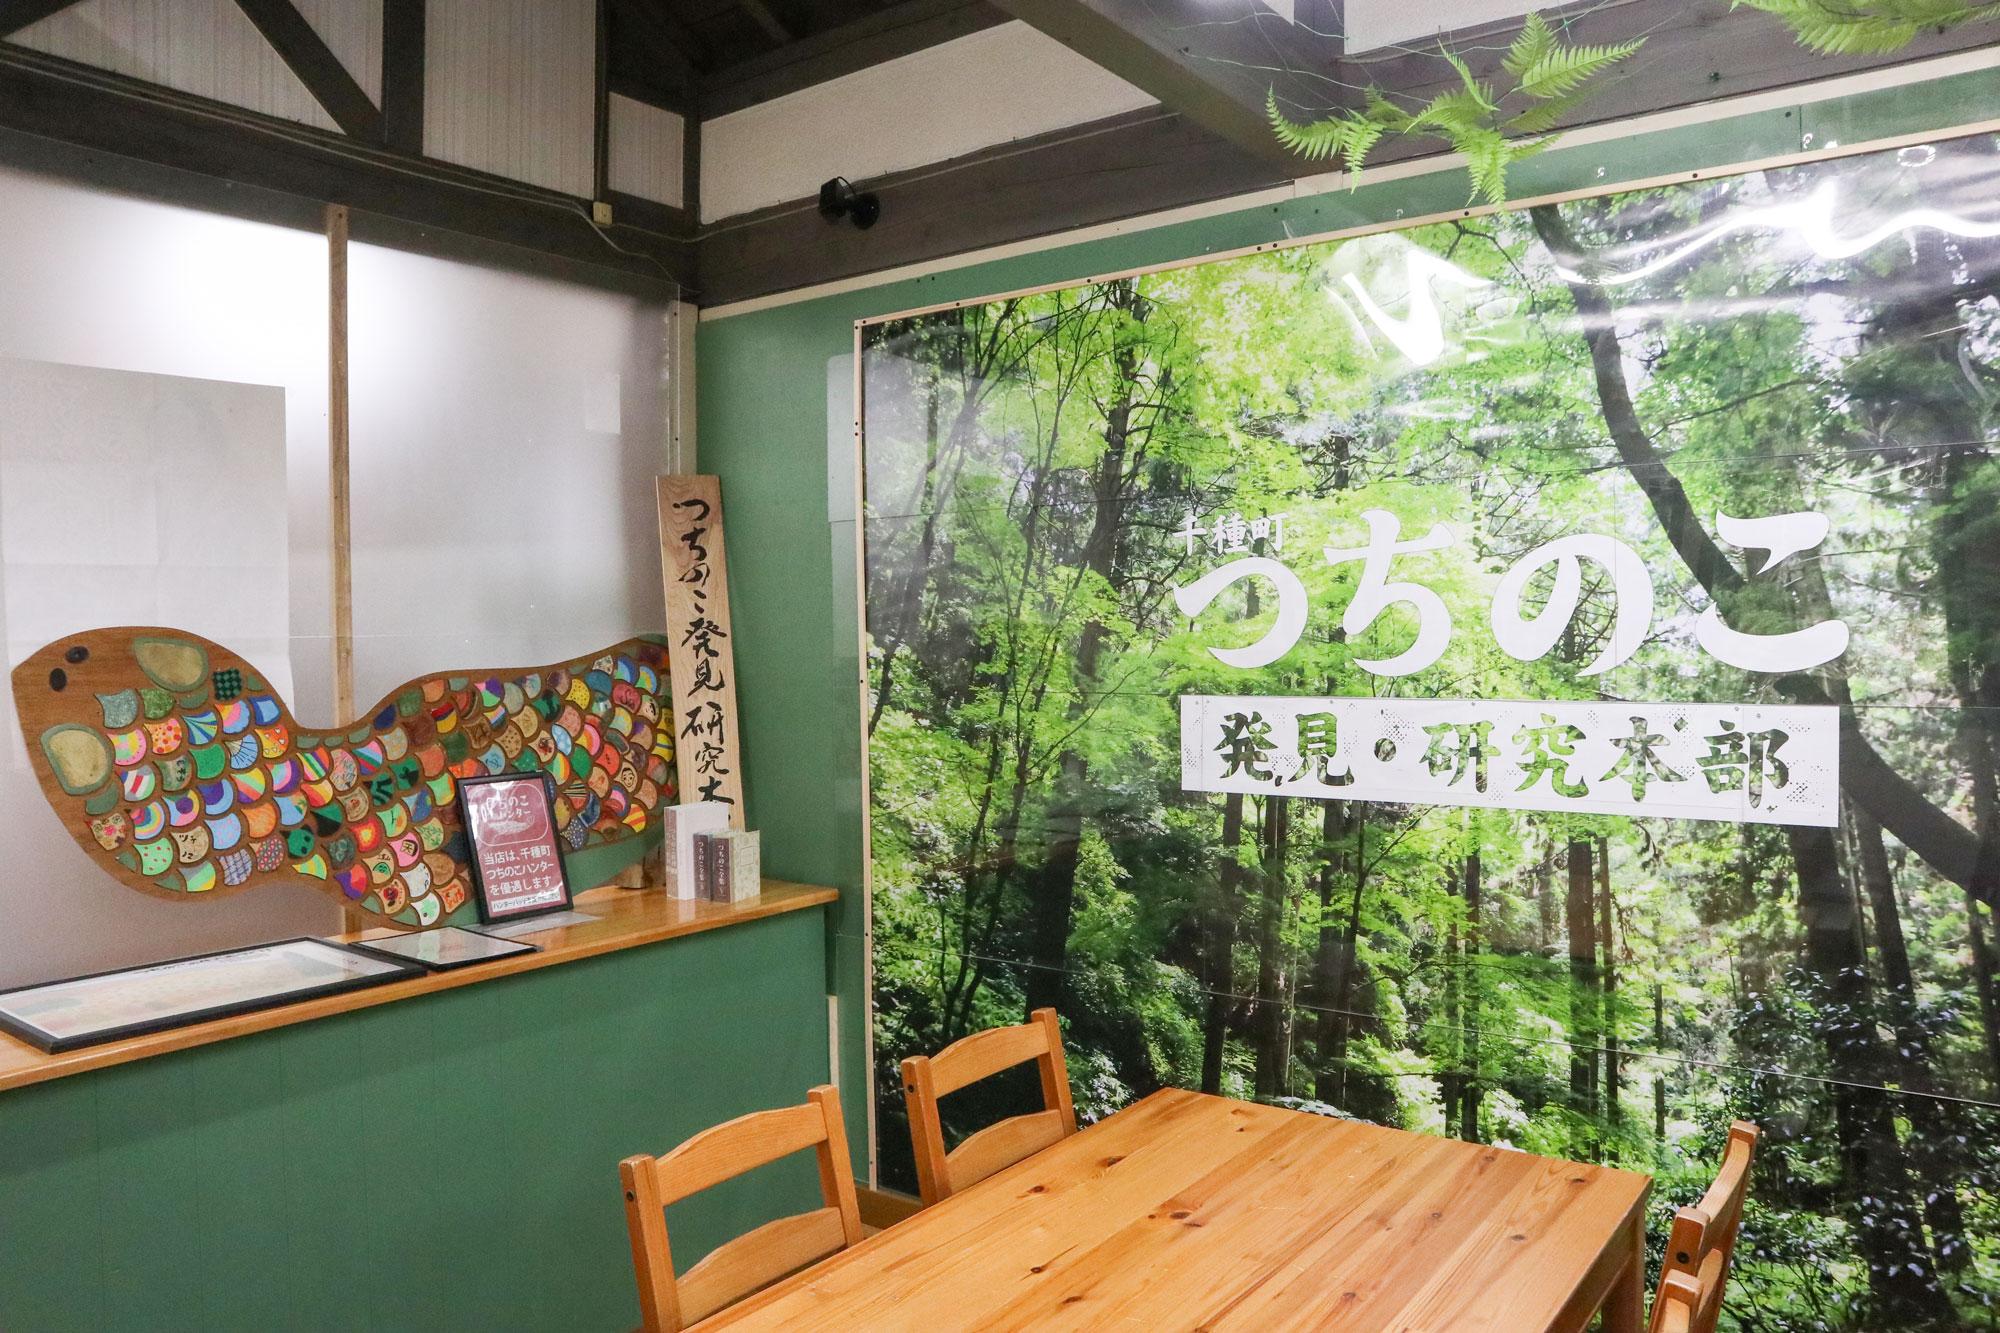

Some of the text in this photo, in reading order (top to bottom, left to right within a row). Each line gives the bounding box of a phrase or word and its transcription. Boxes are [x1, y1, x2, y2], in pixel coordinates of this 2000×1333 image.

[1172, 511, 1289, 557] 千種町
[1174, 508, 1851, 678] つちのこ
[672, 498, 735, 806] つちのこ発見研究本
[486, 861, 554, 879] つちのこハンター
